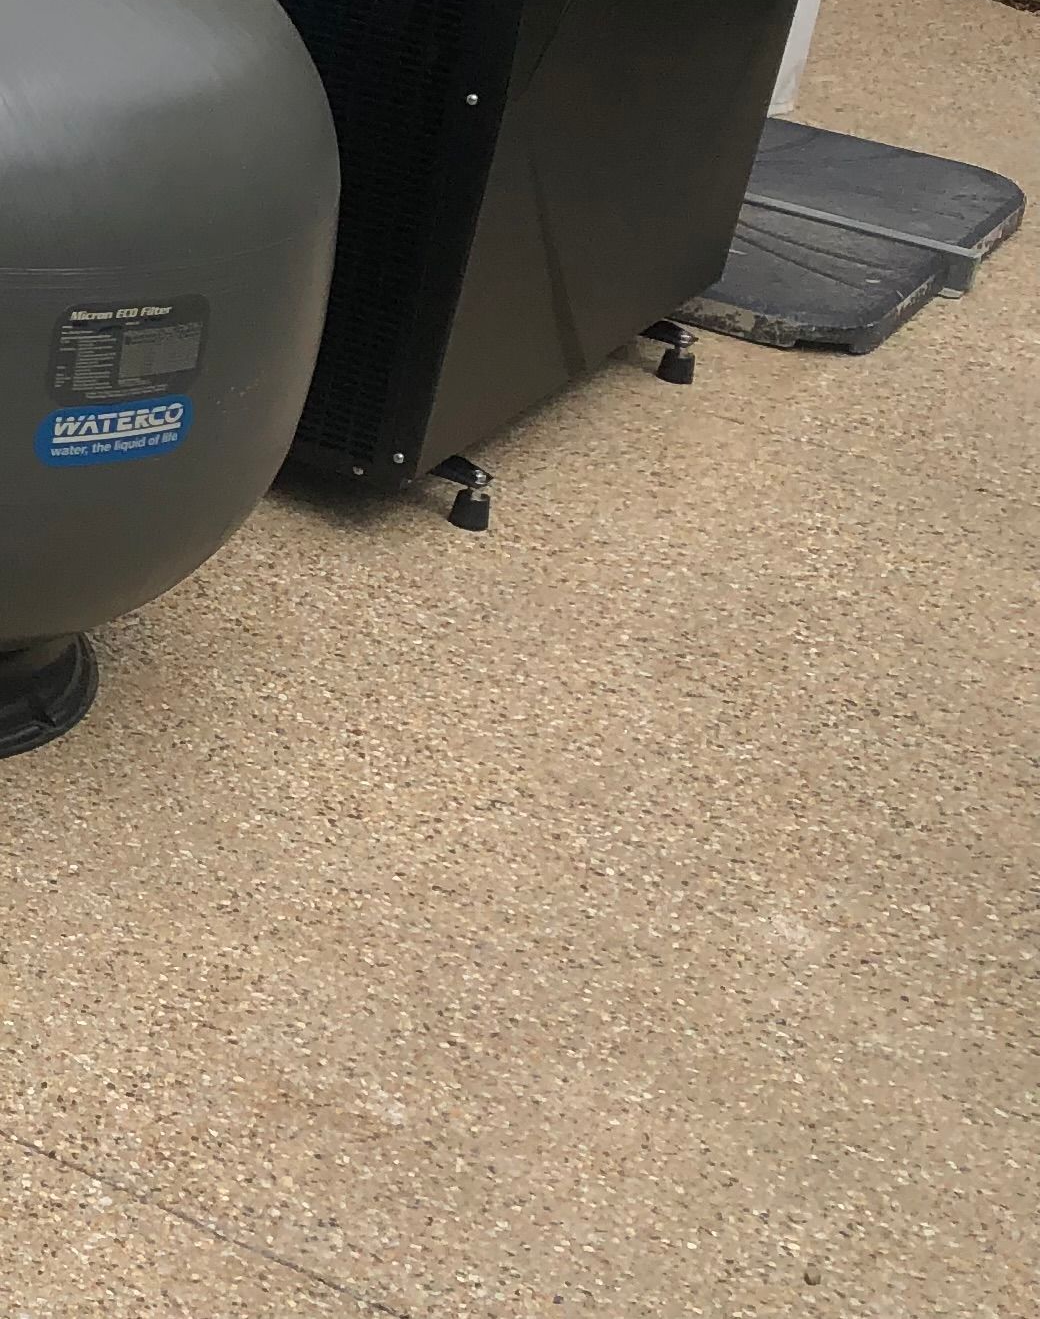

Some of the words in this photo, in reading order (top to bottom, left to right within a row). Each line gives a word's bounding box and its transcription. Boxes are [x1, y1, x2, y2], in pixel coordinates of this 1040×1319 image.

[70, 311, 113, 321] Micron
[116, 308, 139, 319] ECO
[140, 306, 173, 316] Filter
[54, 402, 184, 436] WATERCO
[50, 445, 89, 456] water,
[92, 442, 112, 454] the
[113, 438, 147, 452] liquid
[147, 433, 161, 446] of
[161, 432, 178, 444] life
